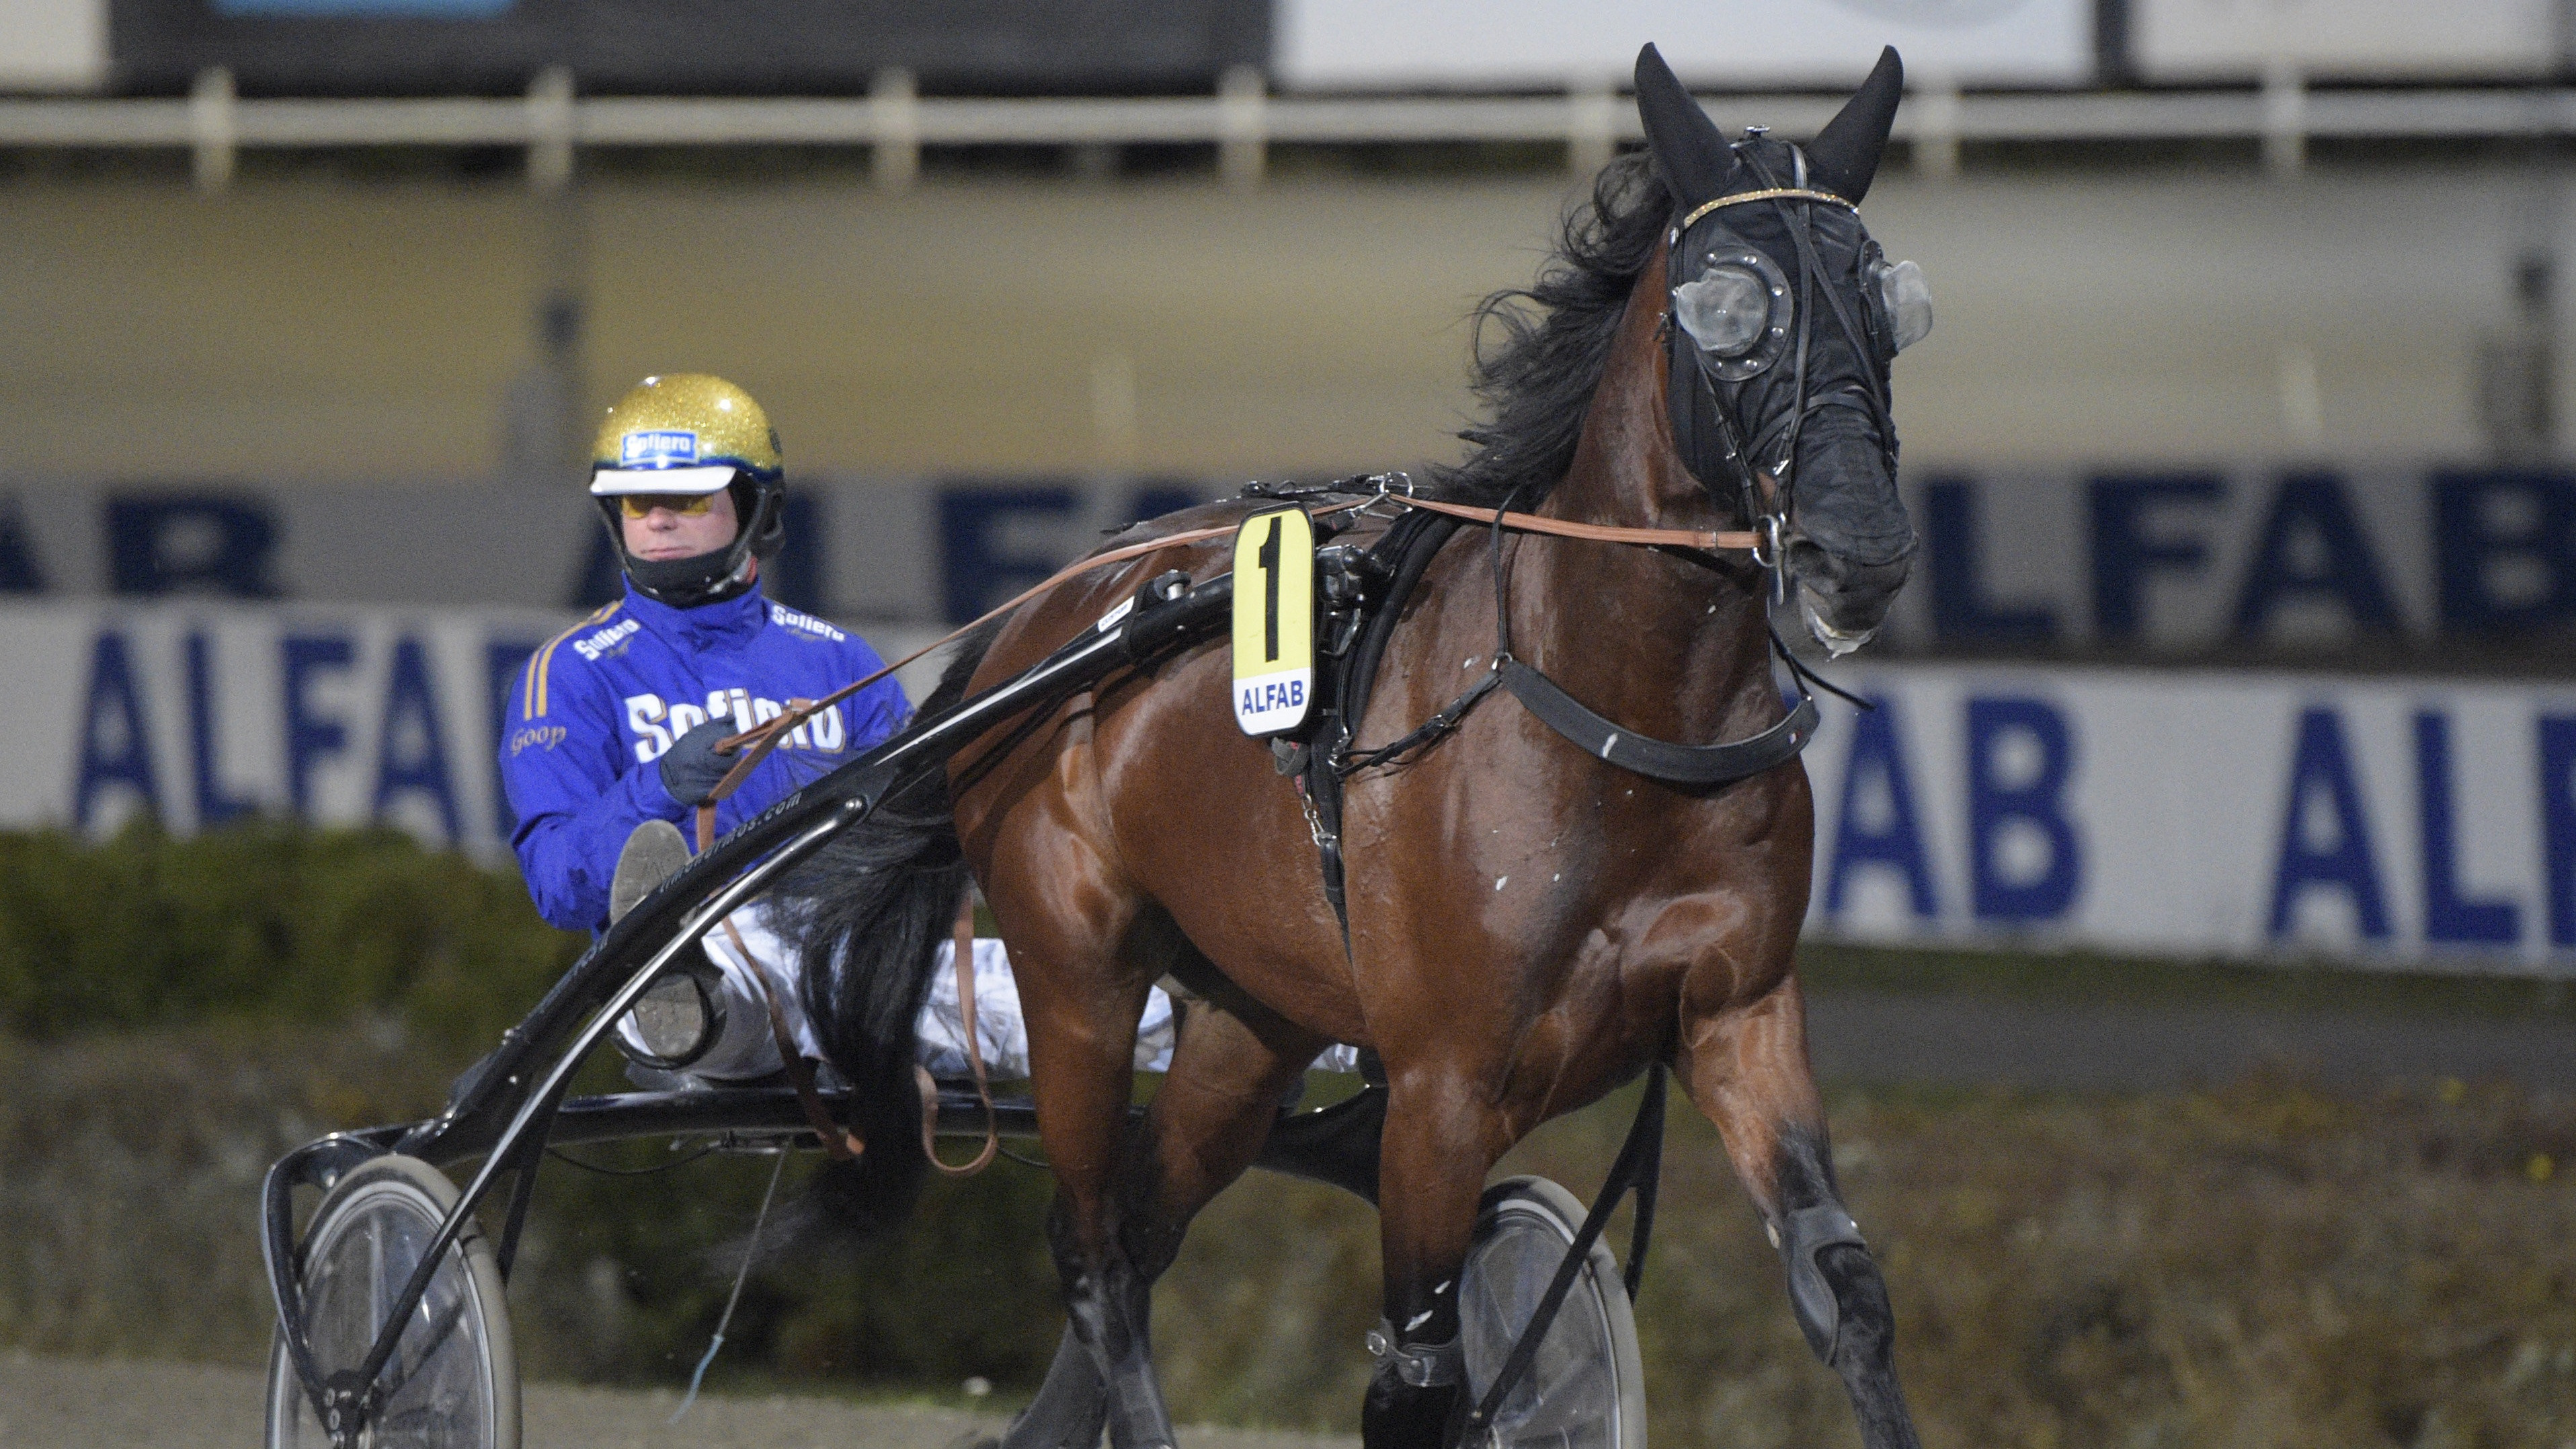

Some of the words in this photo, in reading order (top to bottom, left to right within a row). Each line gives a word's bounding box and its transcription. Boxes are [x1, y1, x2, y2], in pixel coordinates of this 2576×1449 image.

[1258, 516, 1282, 662] 1
[573, 619, 641, 661] Sofiero
[770, 604, 846, 643] Sofiero
[1242, 679, 1304, 715] ALFAB
